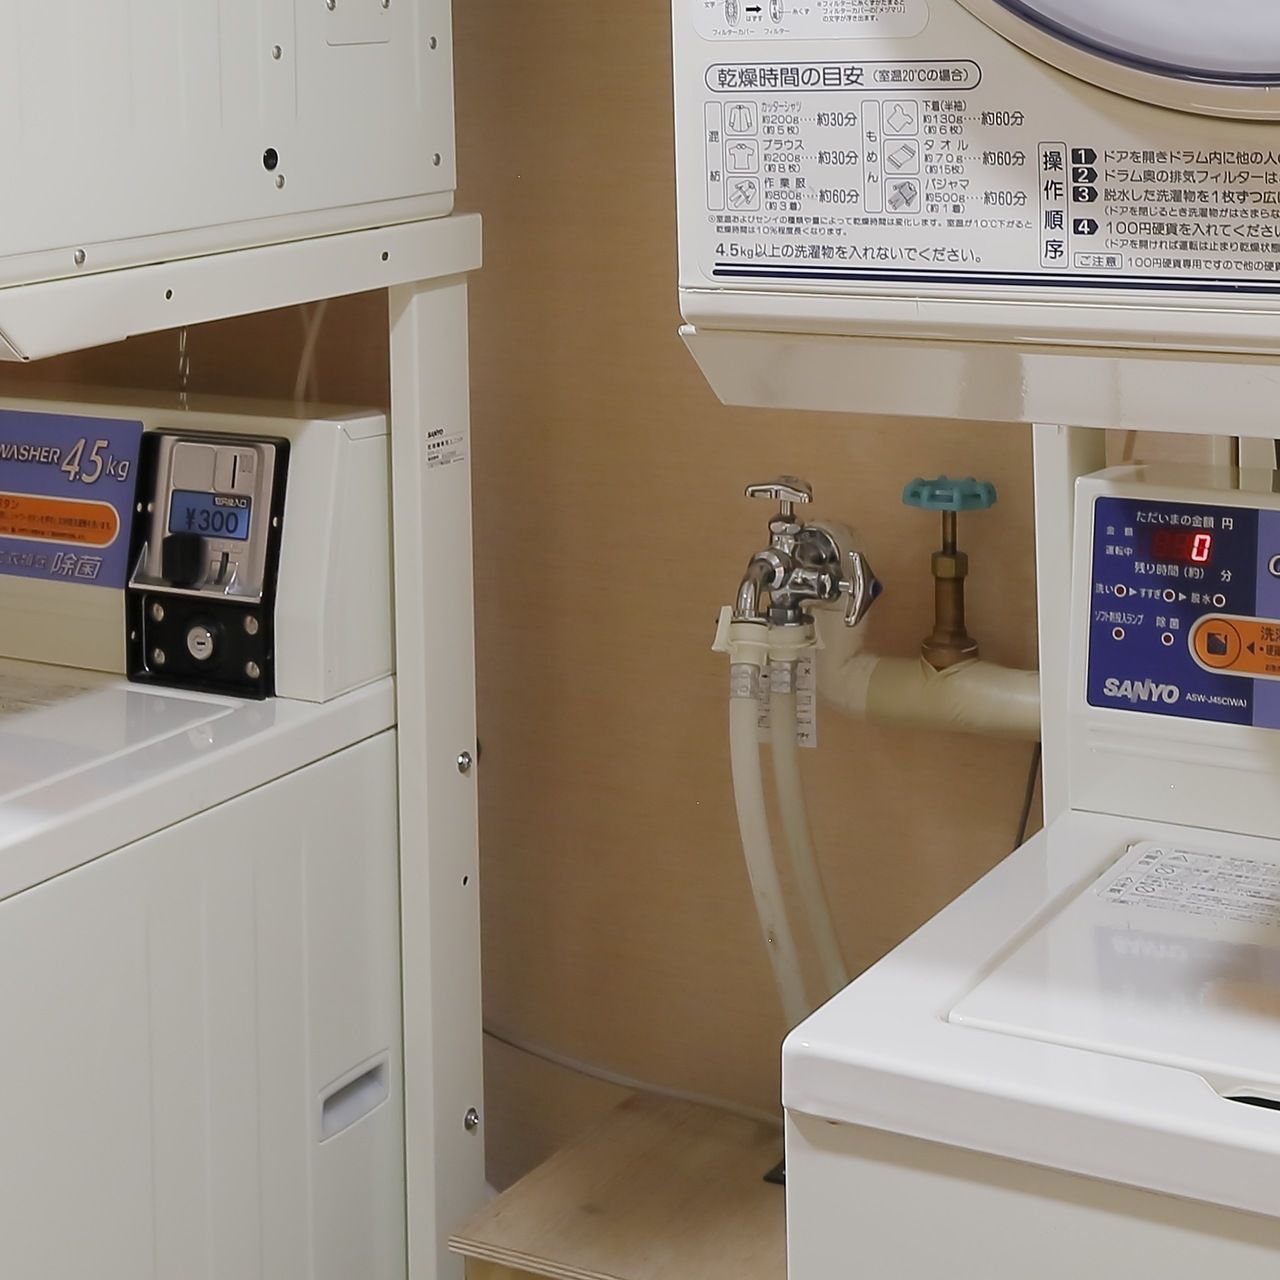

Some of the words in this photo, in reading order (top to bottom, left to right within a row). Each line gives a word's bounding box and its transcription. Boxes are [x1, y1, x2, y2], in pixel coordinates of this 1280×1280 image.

[718, 67, 865, 88] 乾燥時間の目安
[1043, 151, 1064, 261] 操作順序
[60, 438, 109, 484] 4.5
[106, 454, 131, 480] kg
[186, 507, 239, 533] ¥300
[1136, 511, 1215, 529] ただいまの金額
[1221, 517, 1233, 531] 円
[1191, 534, 1211, 562] 0
[50, 551, 103, 580] 除菌
[1220, 570, 1232, 582] 分
[1104, 678, 1180, 704] SANYO
